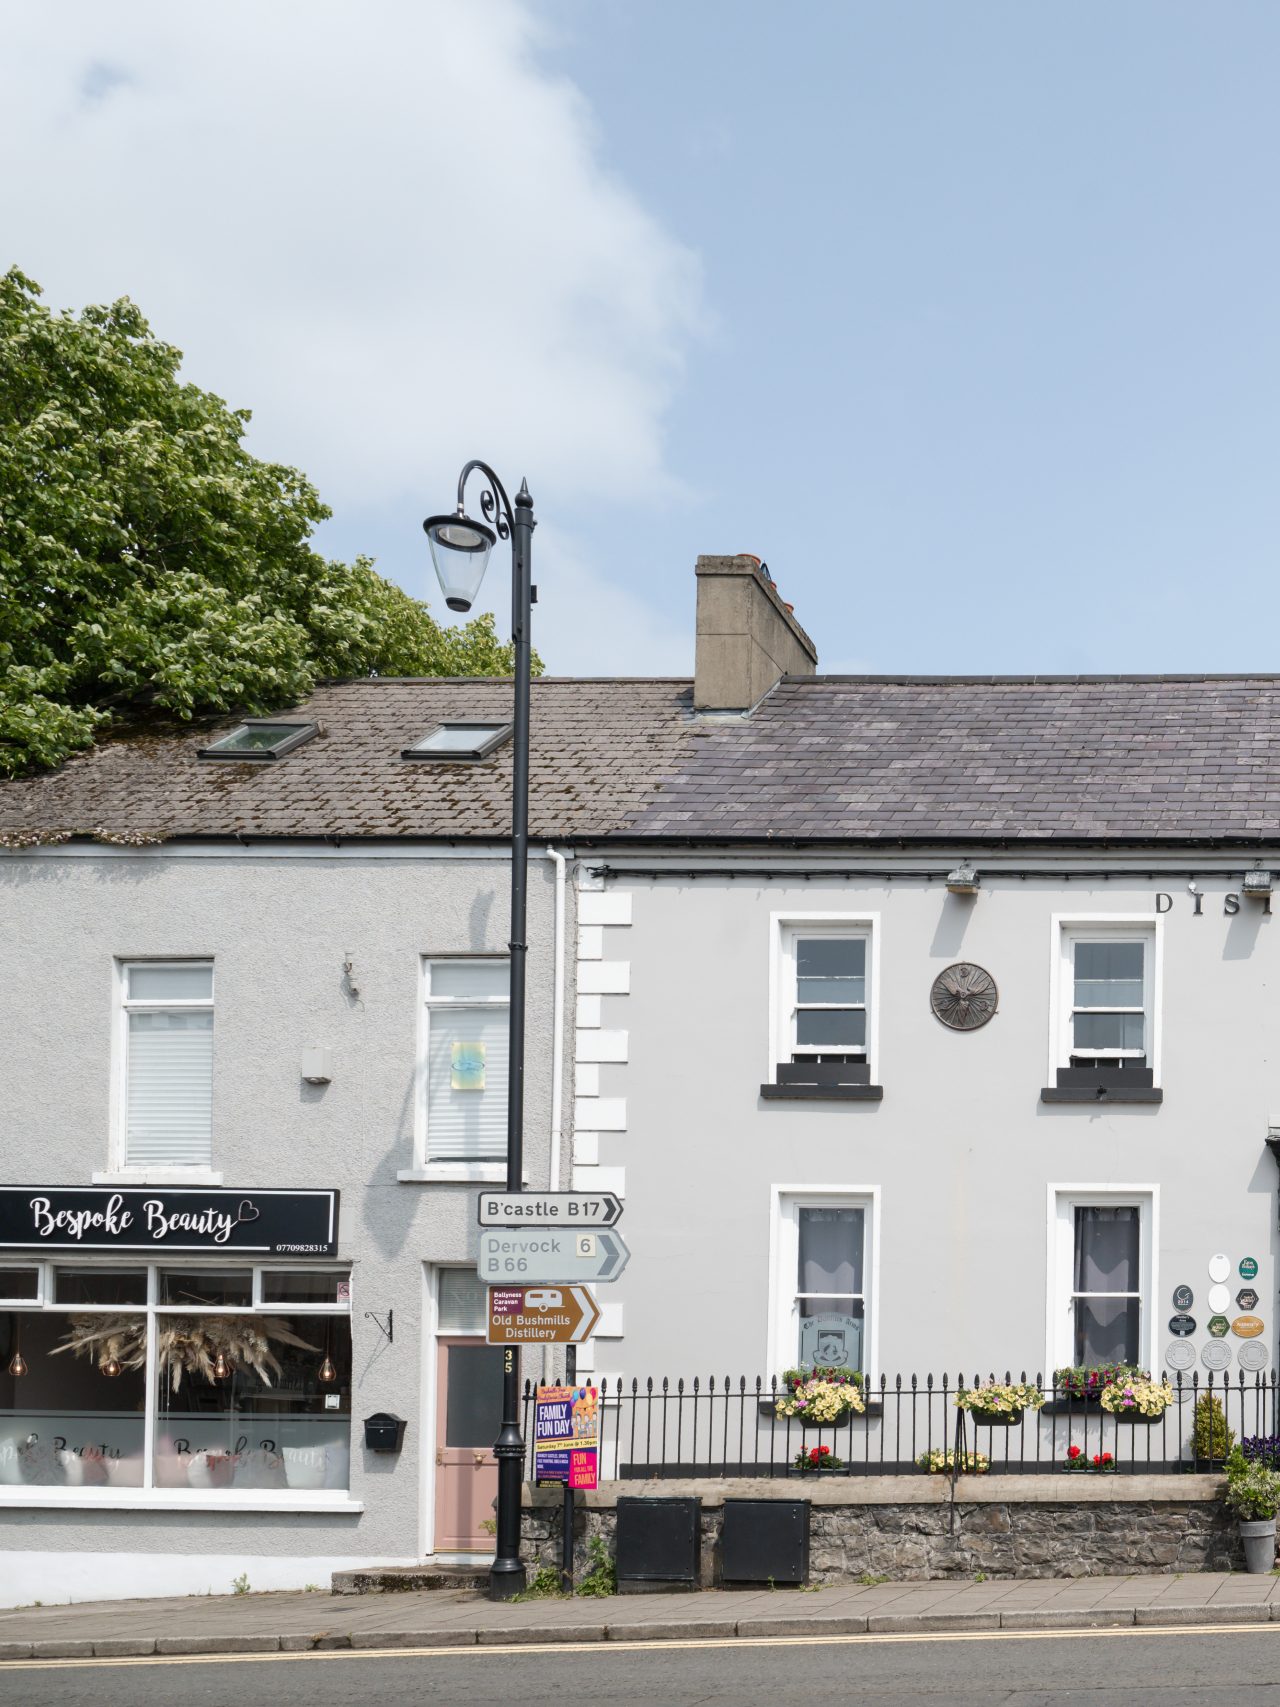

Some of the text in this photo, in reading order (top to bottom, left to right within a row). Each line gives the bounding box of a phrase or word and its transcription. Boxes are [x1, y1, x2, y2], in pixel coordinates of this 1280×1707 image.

[487, 1202, 559, 1216] B'castle
[30, 1194, 239, 1243] Bespoke Beauty
[488, 1238, 591, 1253] Dervock 6
[492, 1315, 571, 1325] Old Bushmills
[505, 1328, 557, 1340] Distillery
[539, 1404, 568, 1420] FAMILY
[537, 1420, 571, 1436] FUN DAY
[573, 1453, 587, 1466] FUN
[574, 1473, 596, 1486] FAMILY
